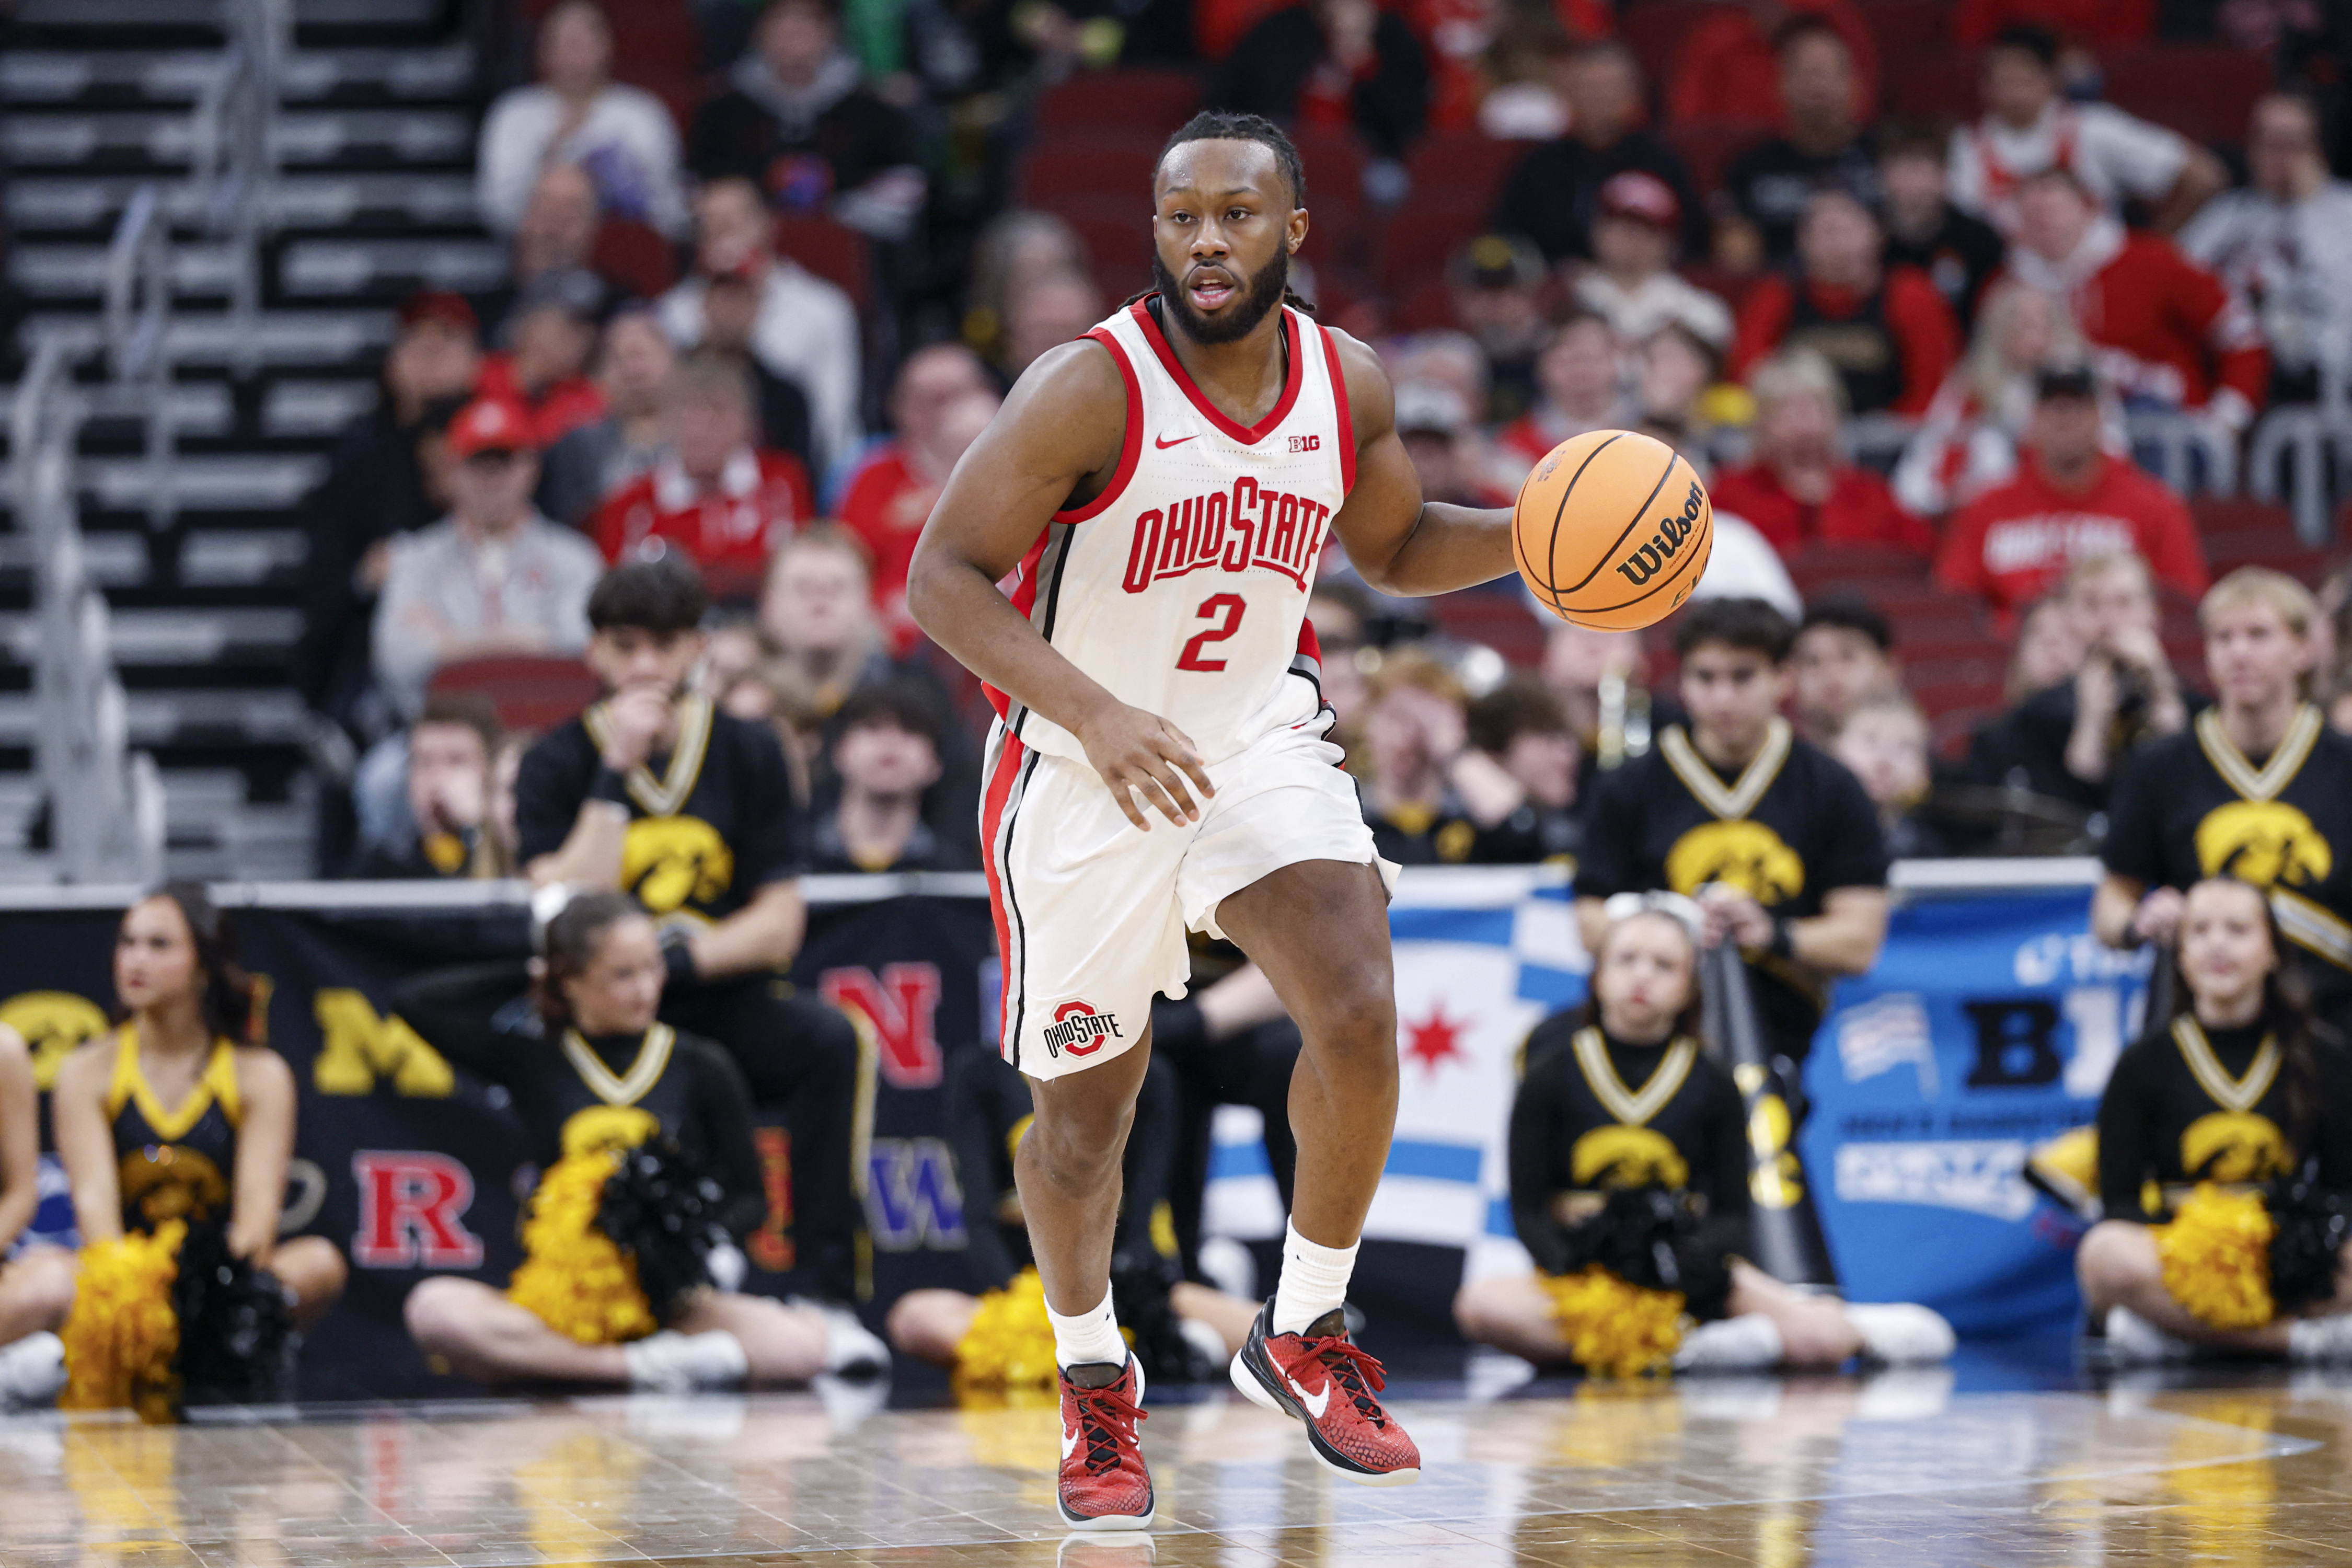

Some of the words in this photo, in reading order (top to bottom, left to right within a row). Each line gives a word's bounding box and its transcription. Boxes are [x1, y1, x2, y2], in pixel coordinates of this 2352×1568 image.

[1616, 480, 1703, 586] Wilson
[1668, 550, 1685, 570] INDOOR
[1685, 534, 1695, 549] GAME
[1175, 592, 1247, 673] 2
[818, 962, 942, 1089] N
[351, 1149, 484, 1270] R
[862, 1137, 970, 1250] W
